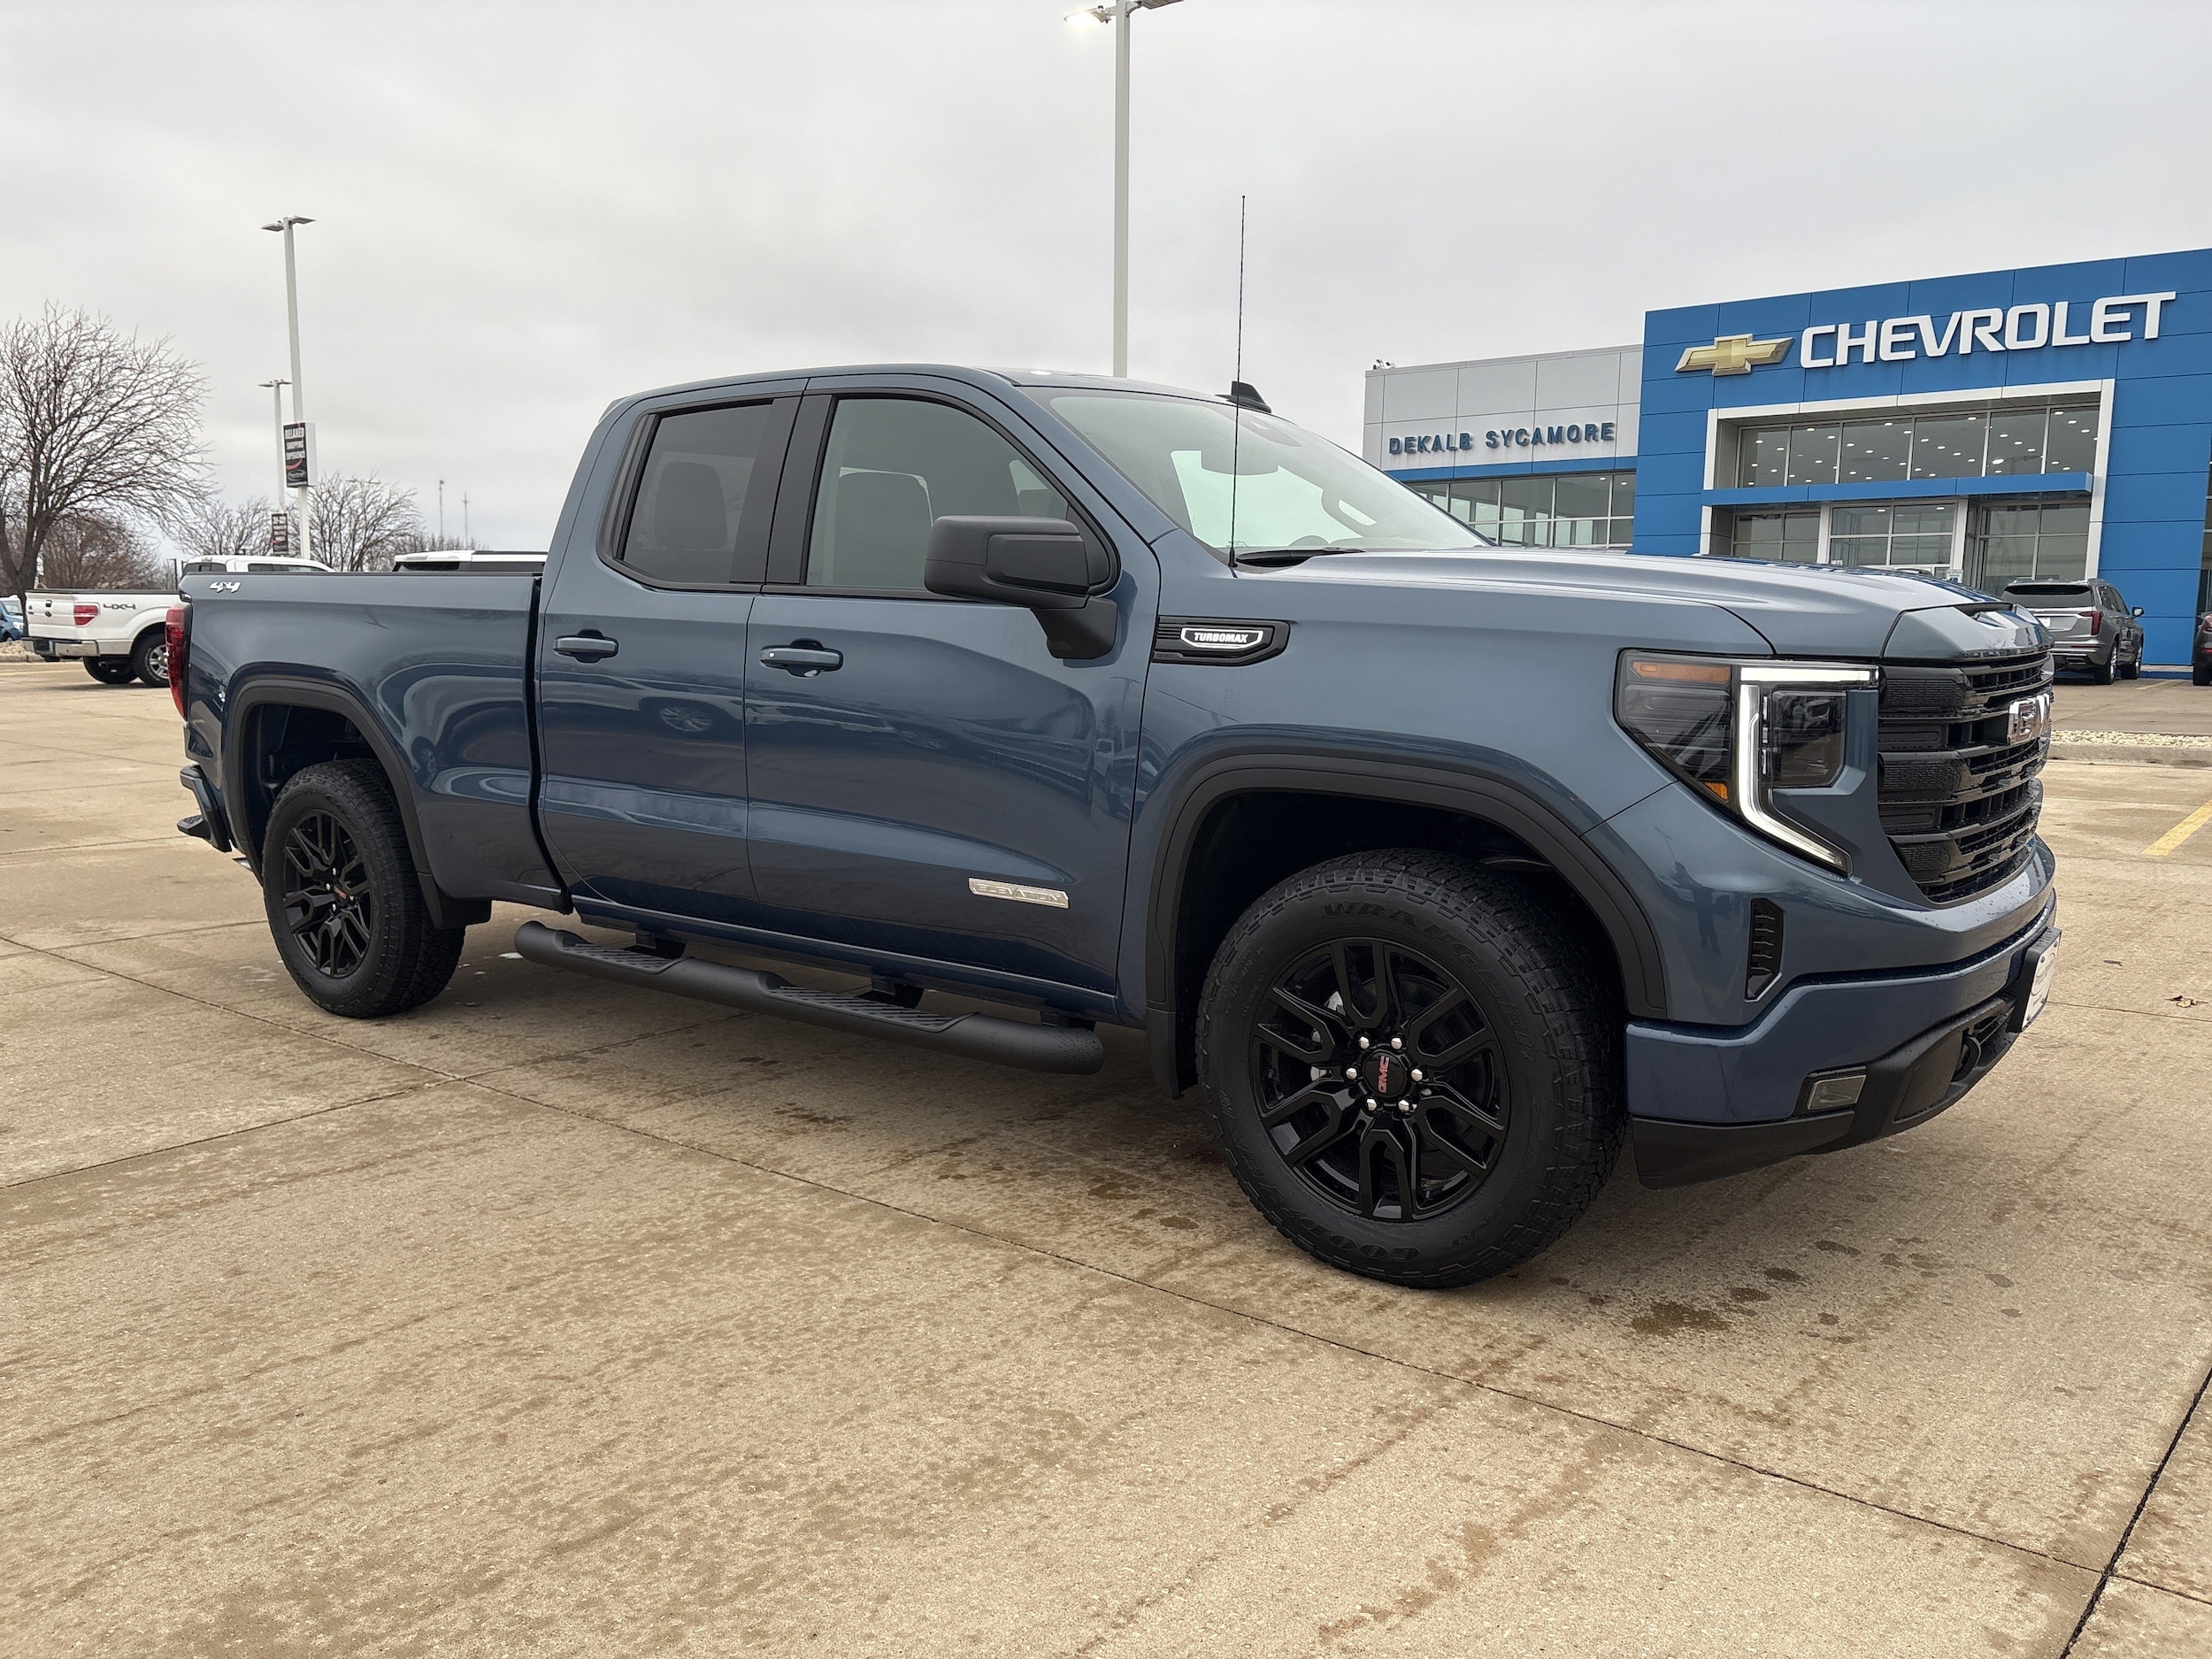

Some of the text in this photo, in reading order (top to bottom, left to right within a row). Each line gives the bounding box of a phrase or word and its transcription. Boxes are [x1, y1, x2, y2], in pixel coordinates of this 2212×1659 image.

[1800, 290, 2177, 369] CHEVROLET
[284, 426, 305, 440] RELAXED
[1388, 422, 1616, 455] DEKALB SYCAMORE
[1194, 632, 1249, 644] TURBOMAX
[975, 883, 1062, 903] ELEVATION
[1321, 901, 1536, 1064] WRANGLER
[1378, 1056, 1390, 1093] GMC
[1218, 1089, 1421, 1261] GOODYEAR
